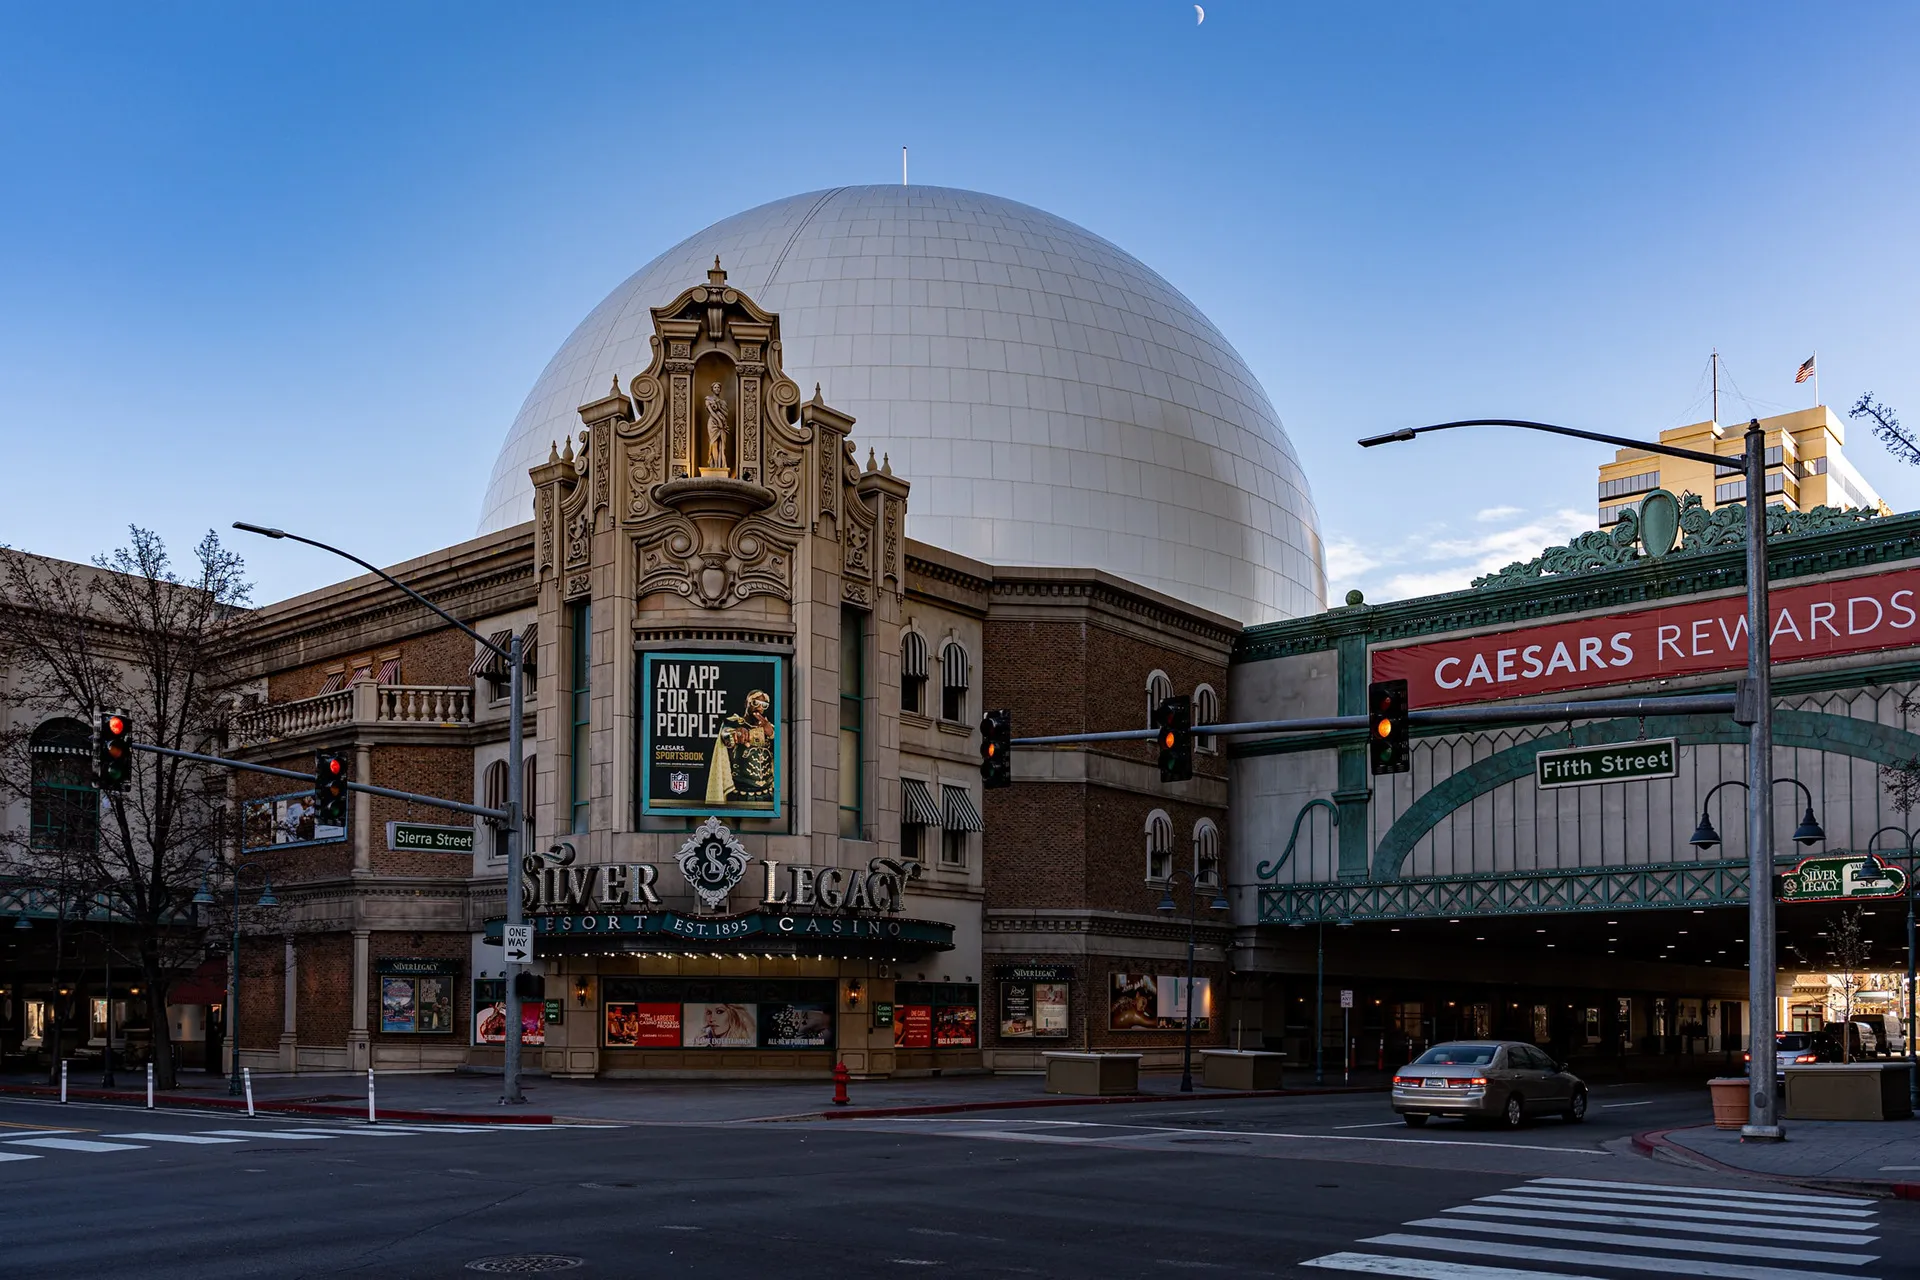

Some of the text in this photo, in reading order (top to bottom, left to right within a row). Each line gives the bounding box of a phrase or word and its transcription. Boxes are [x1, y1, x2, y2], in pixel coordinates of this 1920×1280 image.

[1434, 590, 1917, 690] CAESARS REWARDS
[657, 664, 720, 690] AN APP
[657, 689, 727, 714] FOR THE
[657, 713, 719, 738] PEOPLE
[655, 751, 704, 760] SPORTSBOOK
[1543, 750, 1669, 778] Fifth Street
[673, 781, 687, 790] NFL
[396, 831, 472, 847] Sierra Street
[522, 843, 921, 911] SILVER LEGACY
[1801, 865, 1842, 882] SILVER
[1802, 880, 1839, 892] LEGACY
[509, 928, 527, 937] ONE
[528, 915, 900, 936] RESORT EST. 1895 CASINO
[508, 938, 528, 947] WAY
[1013, 968, 1057, 977] SILVER LEGACY
